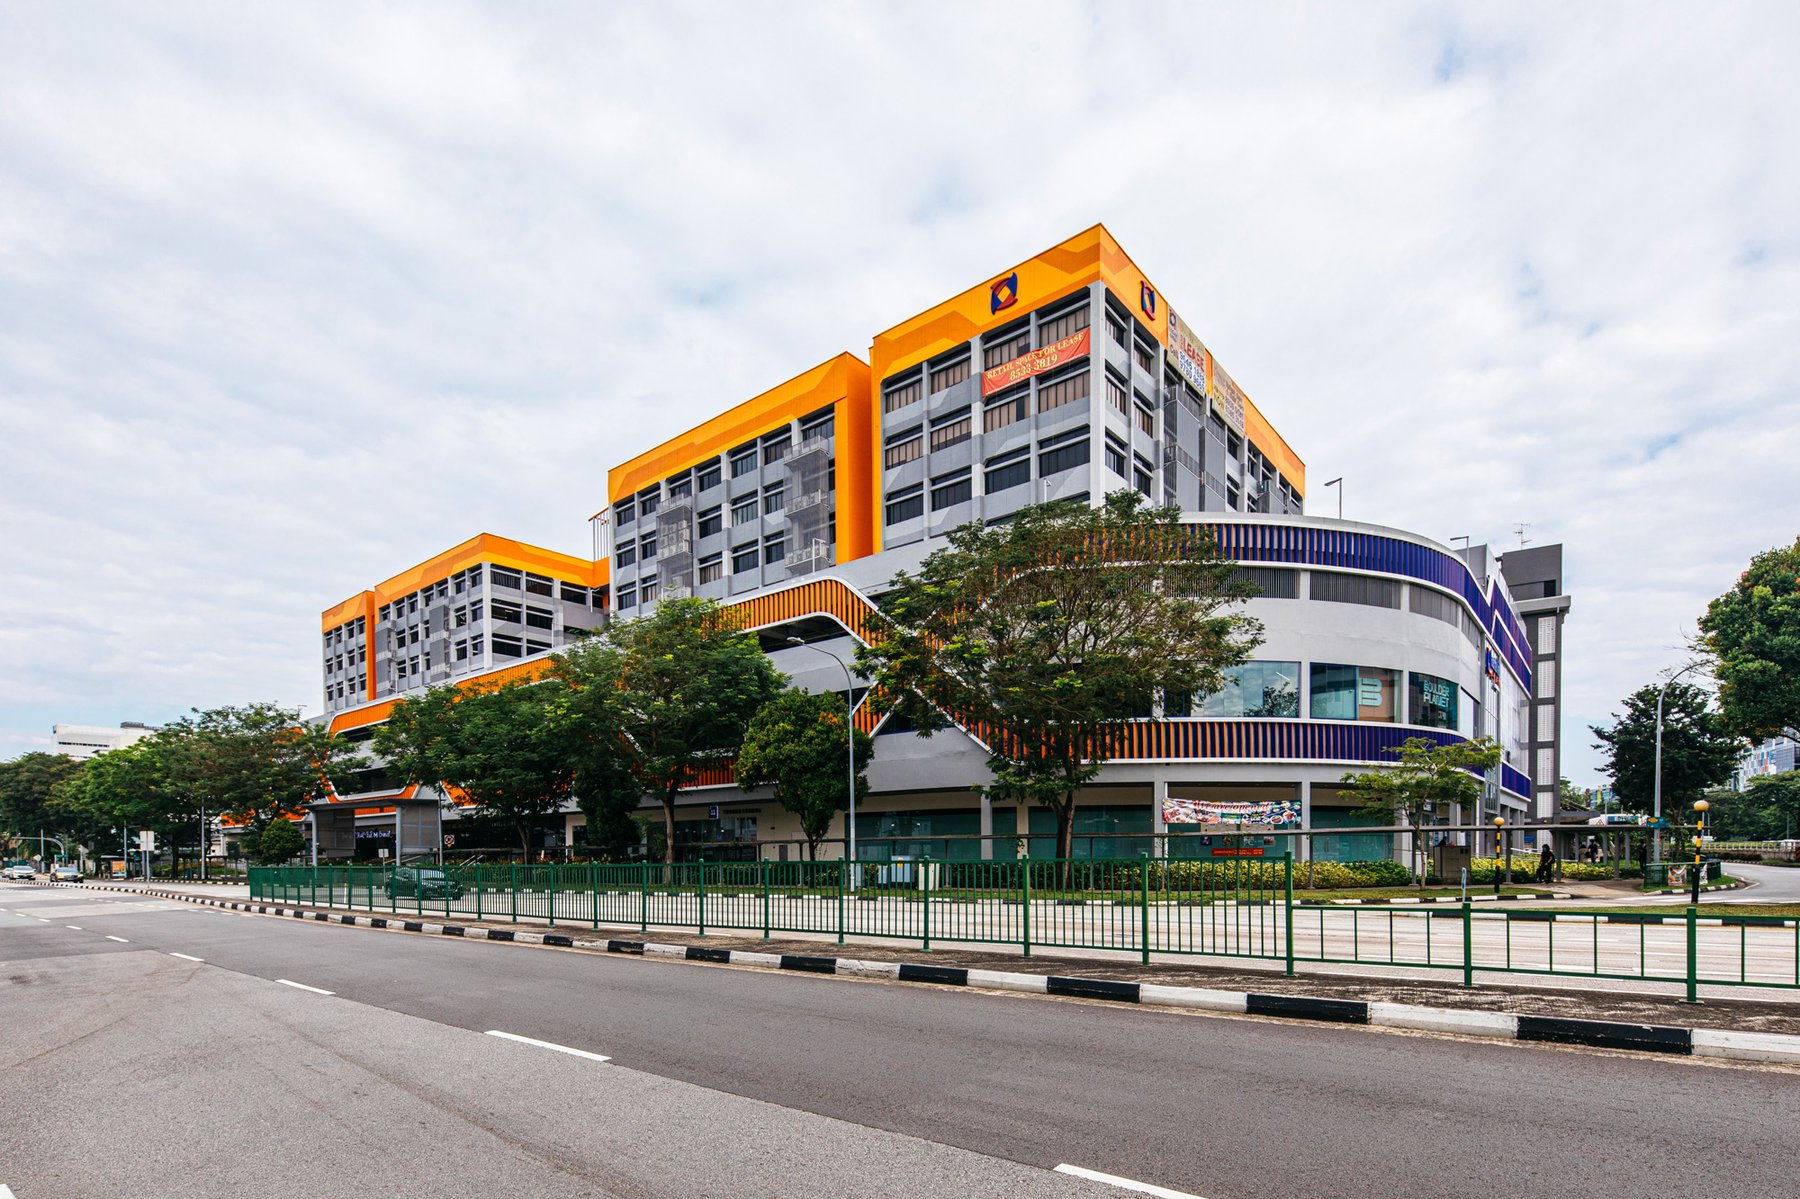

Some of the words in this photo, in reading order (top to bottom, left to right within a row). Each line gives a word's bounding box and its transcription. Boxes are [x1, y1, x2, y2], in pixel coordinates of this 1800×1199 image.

[987, 362, 1015, 379] RETAIL
[1016, 351, 1037, 366] SPACE
[1039, 345, 1056, 358] FOR
[1057, 332, 1085, 351] LEASE
[1009, 364, 1032, 381] 8533
[1034, 354, 1058, 371] 3819
[1423, 680, 1450, 698] BOULDER
[1423, 691, 1450, 708] PLANET
